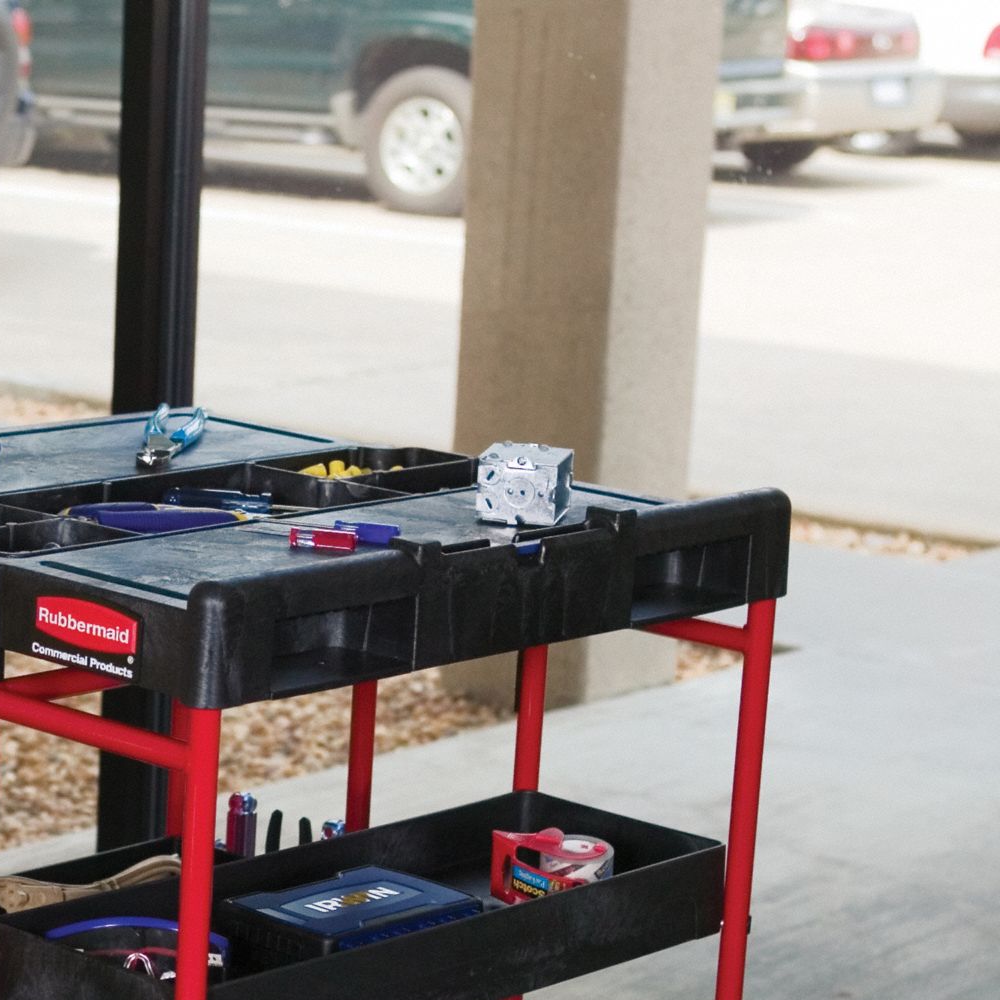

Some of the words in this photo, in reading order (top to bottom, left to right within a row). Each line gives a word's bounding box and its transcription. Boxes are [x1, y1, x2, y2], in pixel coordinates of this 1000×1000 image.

[38, 607, 130, 644] Rubbermaid
[31, 642, 88, 666] Commercial
[89, 657, 133, 679] Products
